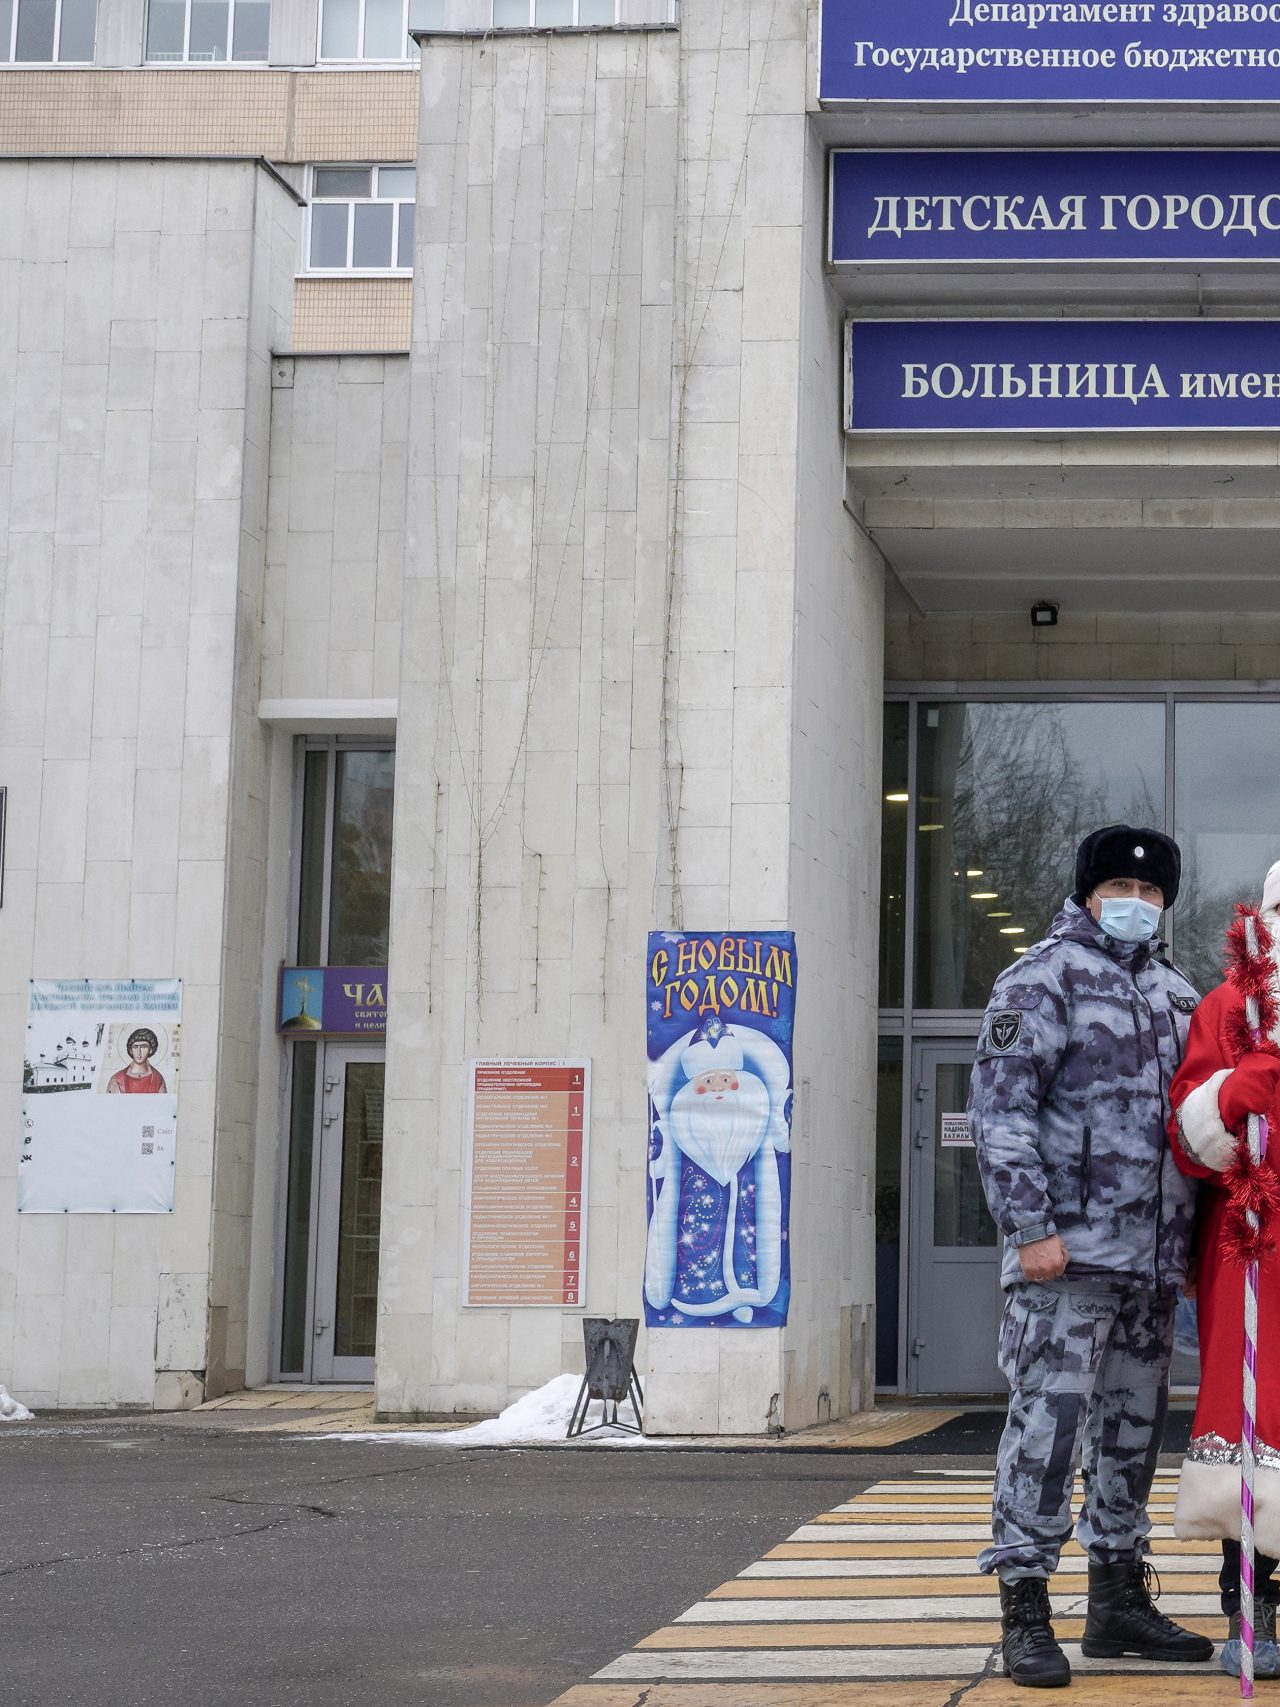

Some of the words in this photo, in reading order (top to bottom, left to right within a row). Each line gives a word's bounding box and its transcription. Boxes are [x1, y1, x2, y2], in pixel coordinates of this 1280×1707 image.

[949, 0, 1155, 29] Департамент
[853, 41, 1117, 73] Государственное
[867, 196, 1087, 239] ДЕТСКАЯ
[901, 363, 1169, 405] БОЛЬНИЦА
[652, 949, 669, 987] С
[675, 937, 793, 988] НОВЫМ
[663, 975, 779, 1018] ГОДОМ!
[571, 1156, 578, 1164] 2
[569, 1221, 576, 1229] 5
[569, 1251, 575, 1259] 6
[568, 1275, 575, 1283] 7
[567, 1292, 574, 1300] 8
